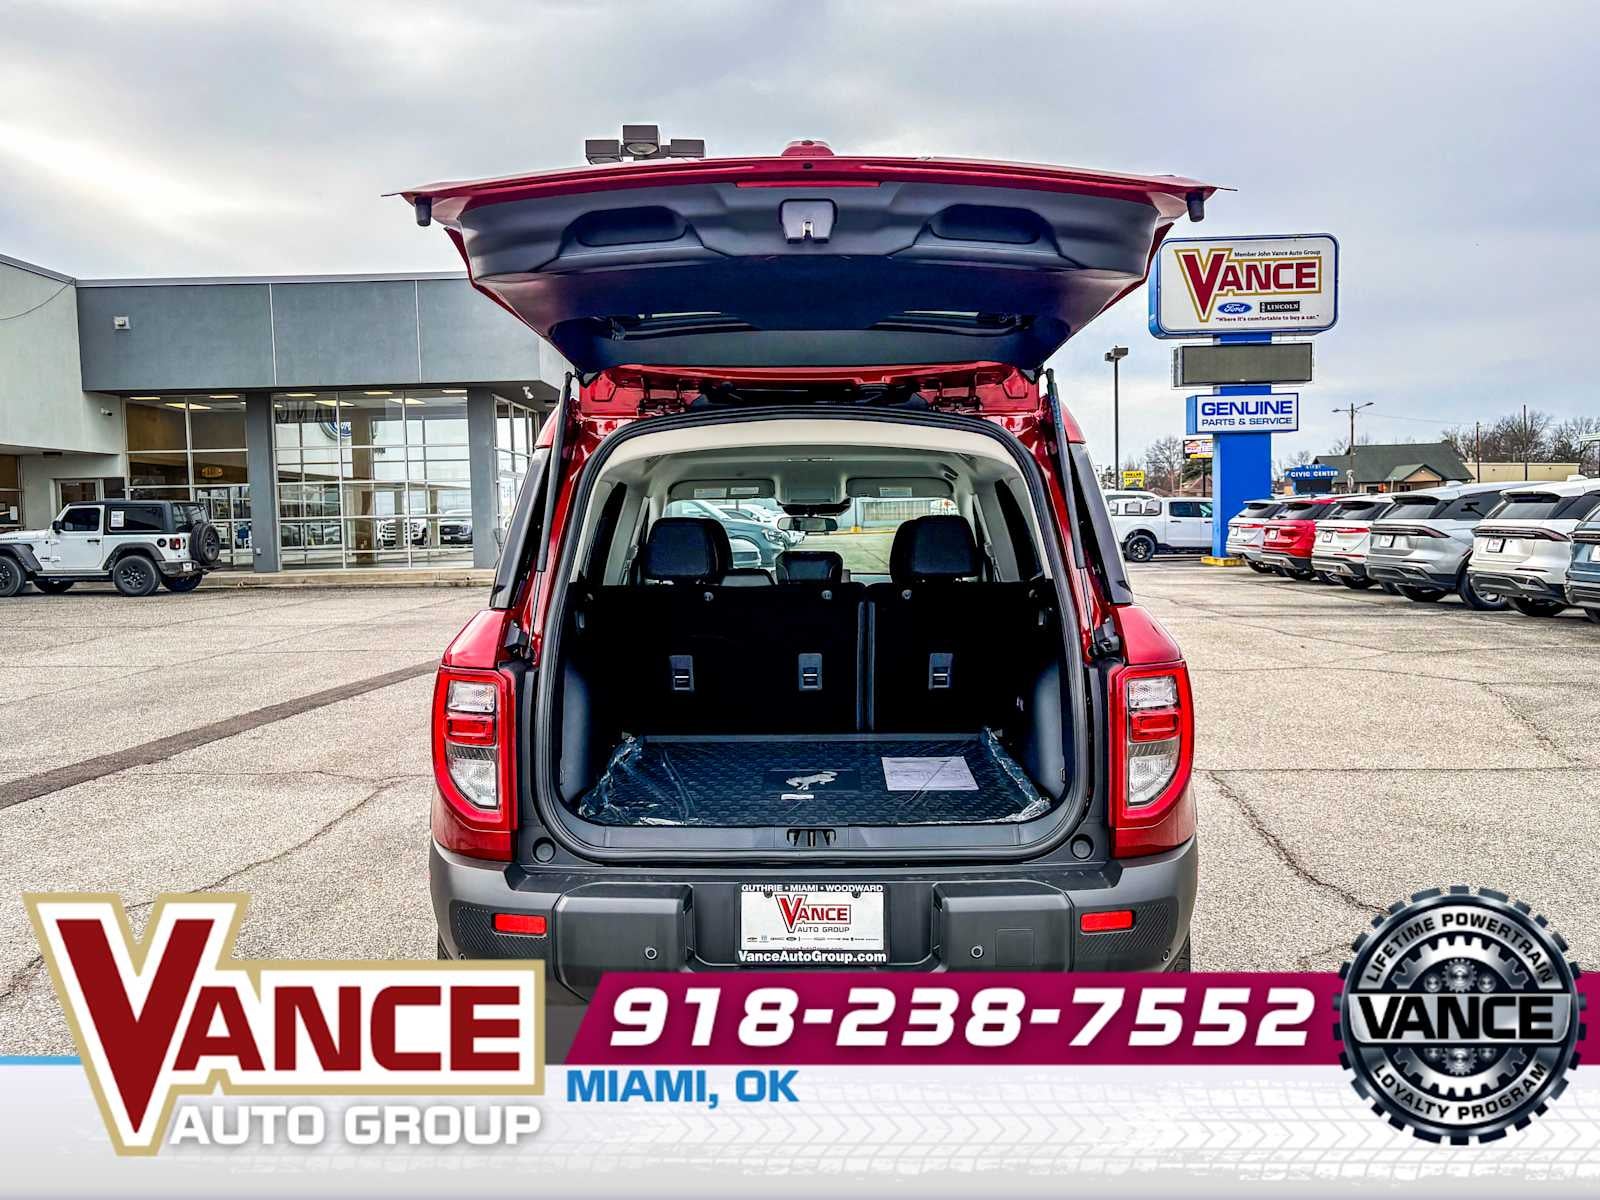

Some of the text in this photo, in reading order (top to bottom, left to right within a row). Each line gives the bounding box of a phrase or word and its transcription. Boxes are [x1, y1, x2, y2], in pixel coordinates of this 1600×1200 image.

[1180, 252, 1318, 316] VANCE
[1222, 302, 1247, 313] Ford
[1266, 302, 1299, 311] LINCOLN
[1201, 400, 1293, 416] GENUINE
[1202, 418, 1235, 426] PARTS
[1249, 417, 1292, 425] SERVICE
[741, 884, 883, 892] GUTHRIE MIAMI WOODWARD
[778, 896, 848, 929] VANCE
[738, 950, 887, 964] VanceAutoGroup.com
